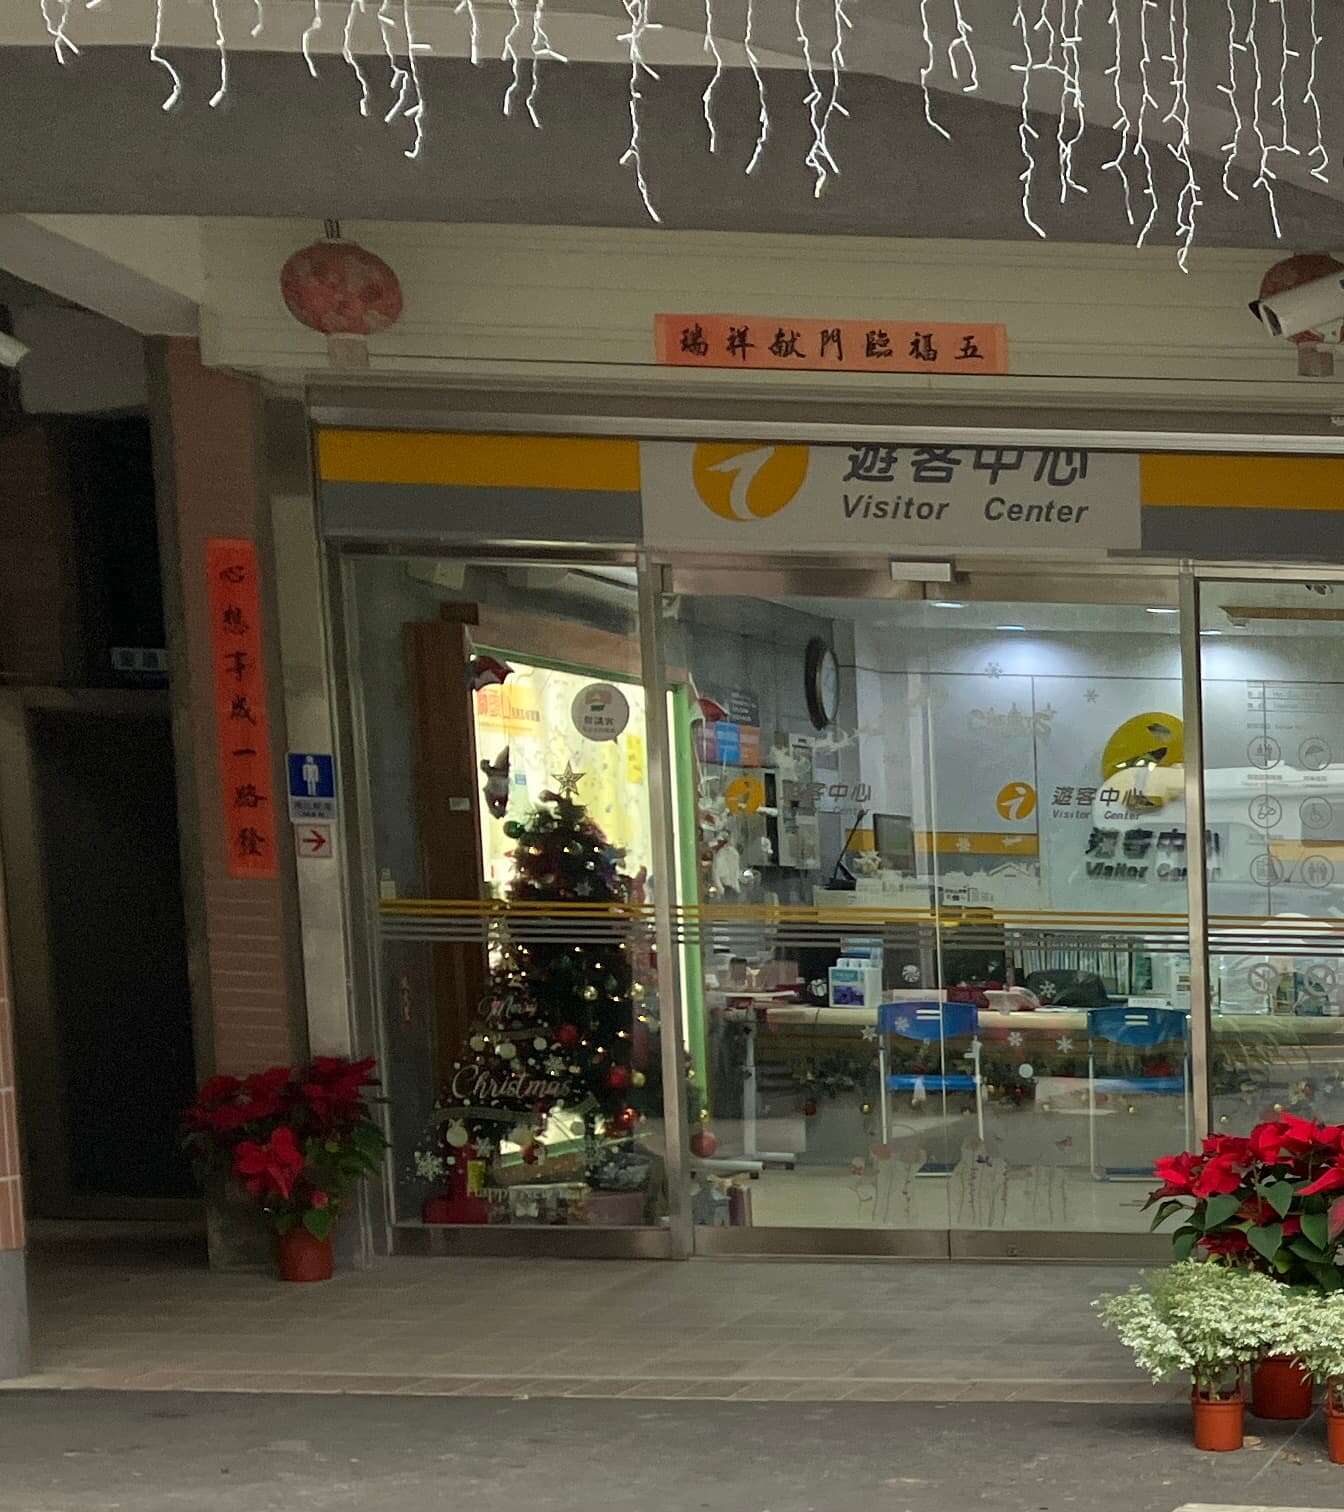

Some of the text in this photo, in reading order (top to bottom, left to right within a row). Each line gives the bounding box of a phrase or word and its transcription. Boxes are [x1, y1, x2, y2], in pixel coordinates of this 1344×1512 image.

[840, 494, 1090, 525] Visitor Center
[1052, 809, 1142, 821] Visitor Center
